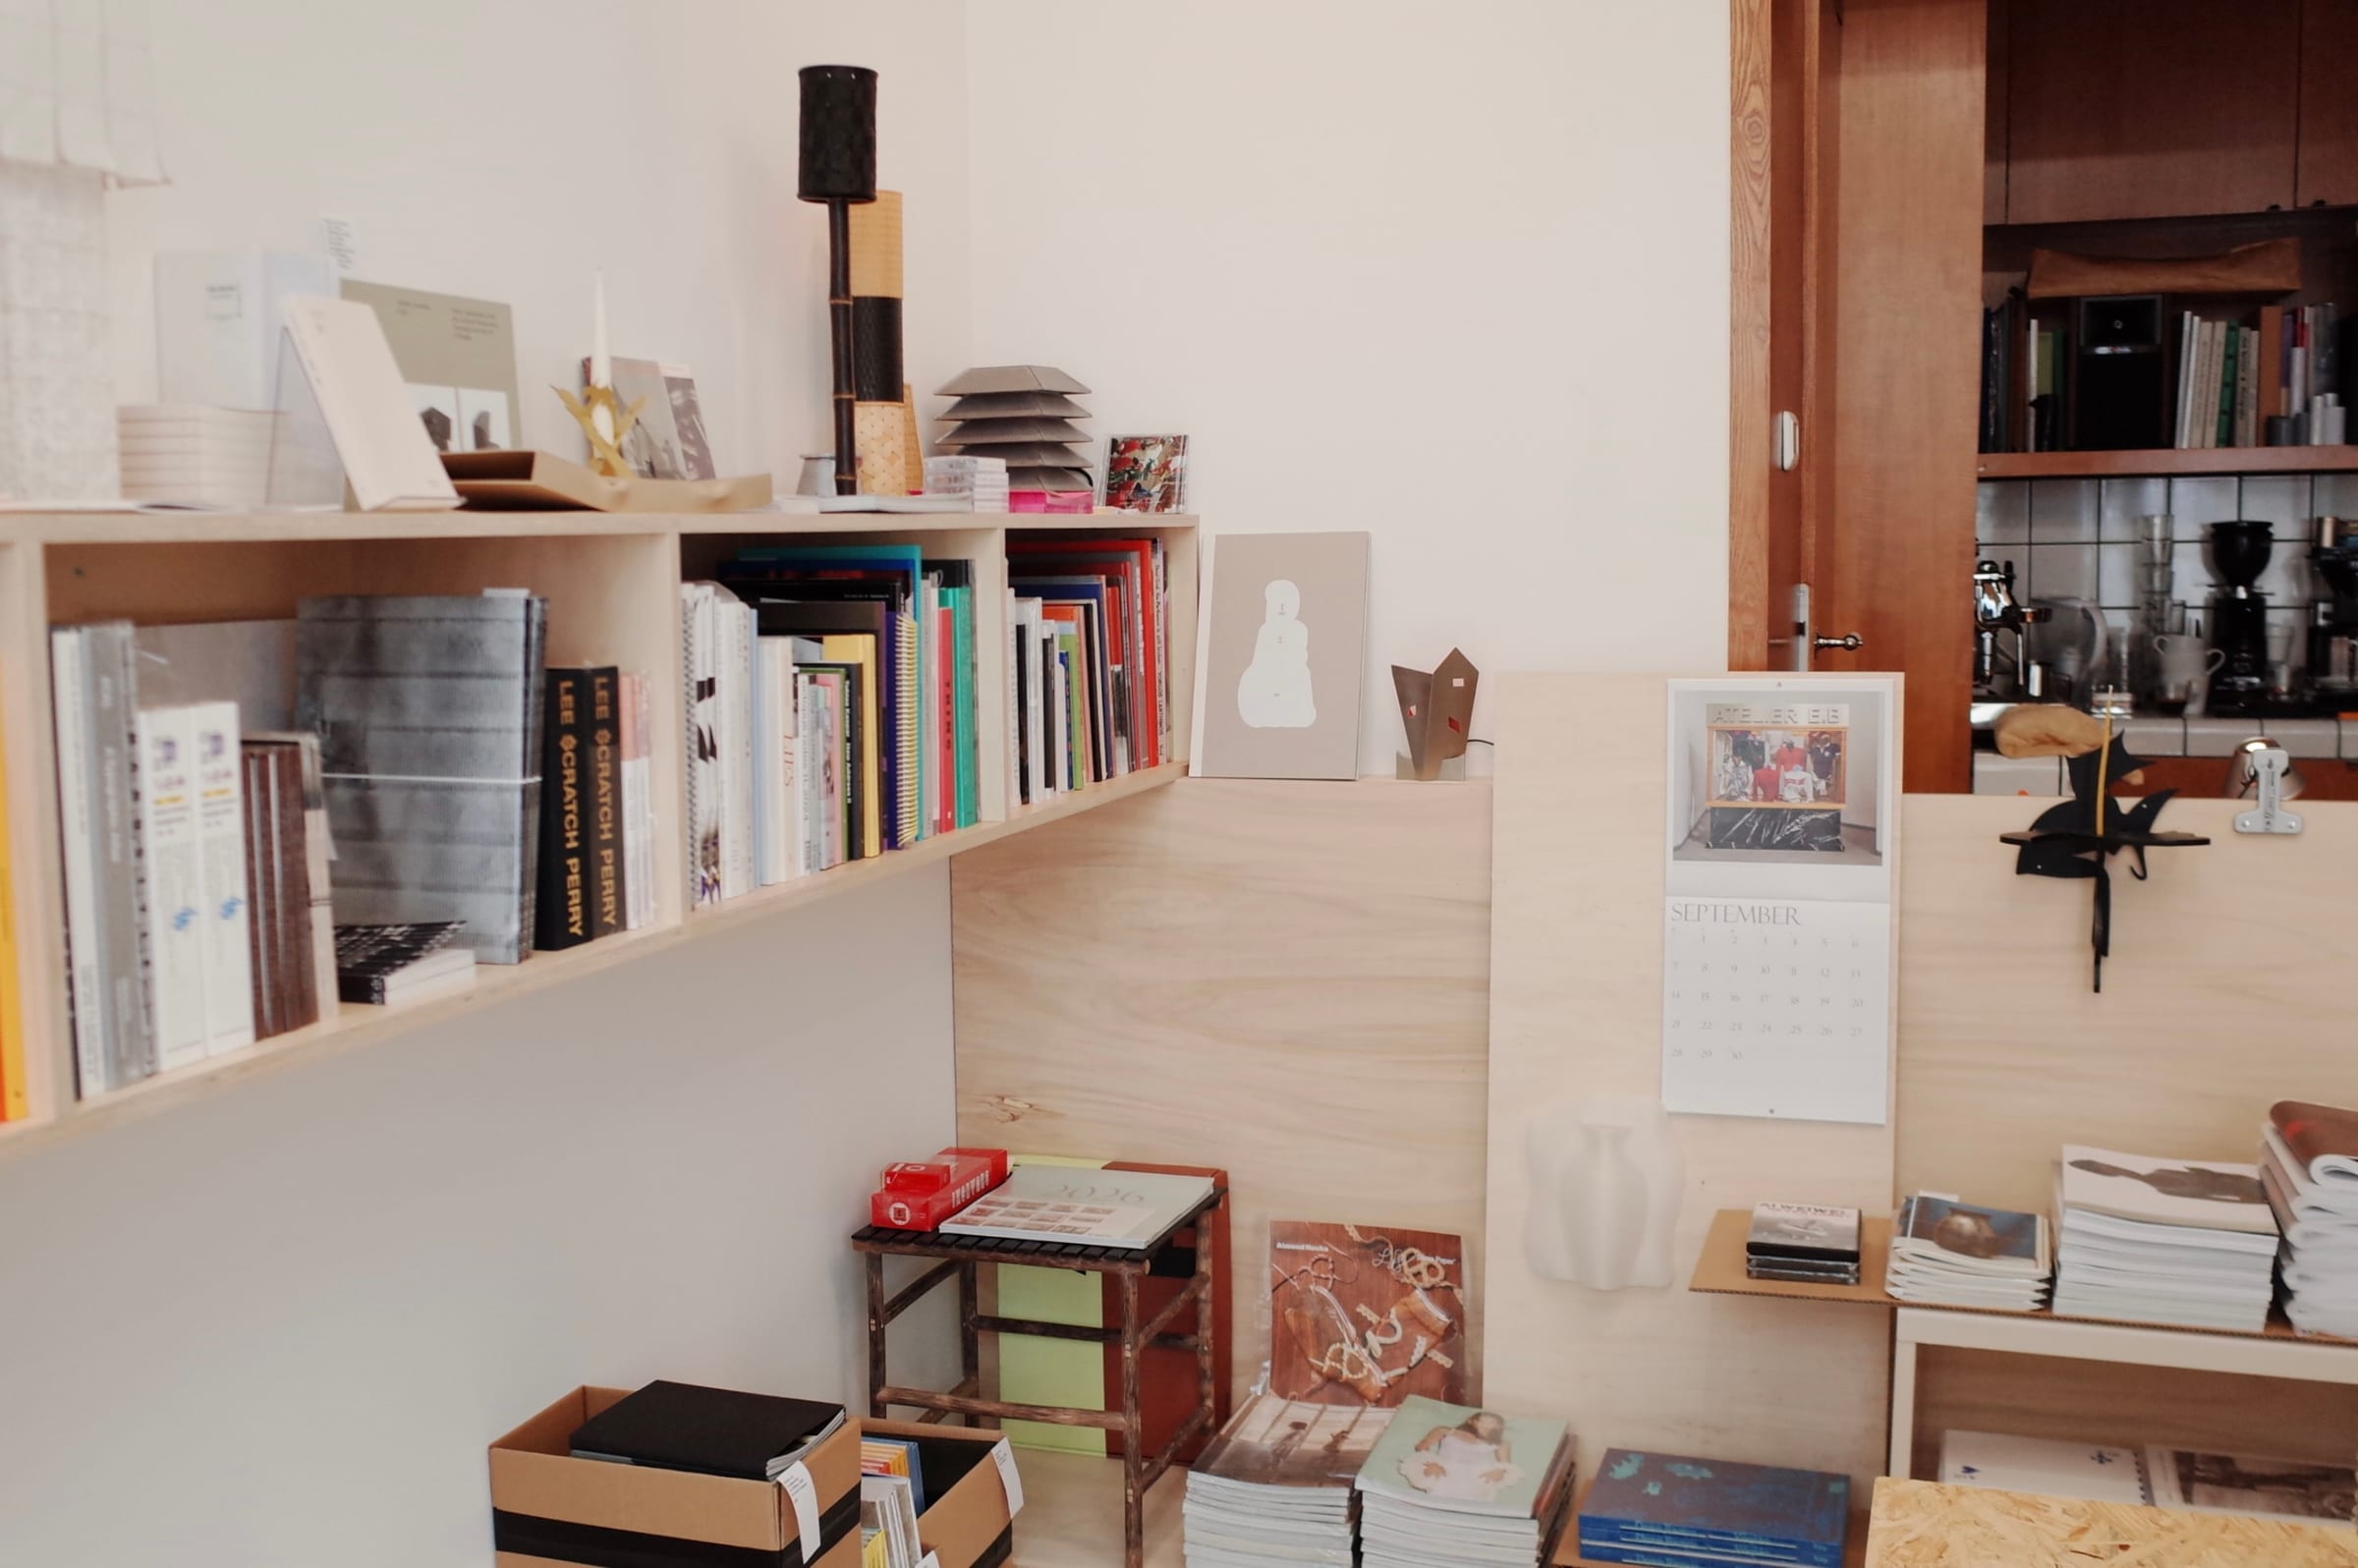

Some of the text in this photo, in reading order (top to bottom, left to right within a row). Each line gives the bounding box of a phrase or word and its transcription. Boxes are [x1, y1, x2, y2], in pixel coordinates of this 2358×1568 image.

[559, 681, 575, 724] LEE
[593, 676, 610, 720] LEE
[1712, 706, 1798, 724] ATELIER
[565, 856, 583, 936] PERRY
[597, 848, 617, 927] PERRY
[1670, 903, 1801, 925] SEPTEMBER
